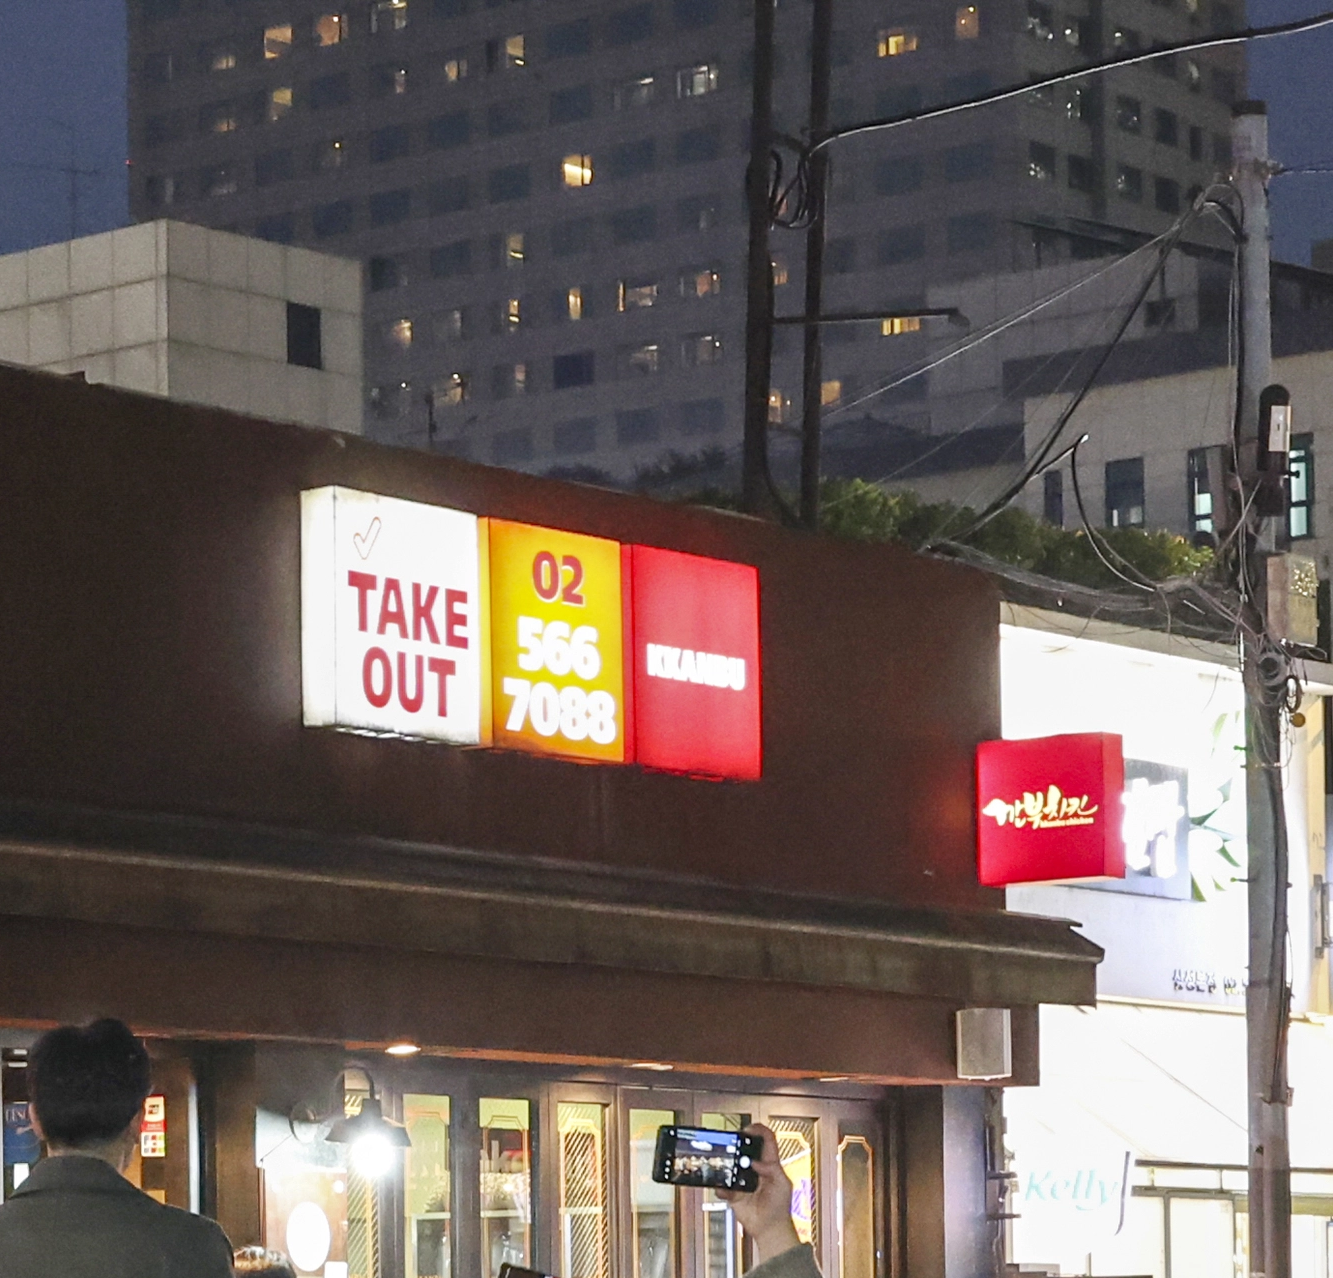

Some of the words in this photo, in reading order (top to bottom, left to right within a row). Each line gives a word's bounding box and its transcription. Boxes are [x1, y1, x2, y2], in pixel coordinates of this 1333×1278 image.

[532, 550, 584, 607] 02
[347, 570, 469, 650] TAKE
[517, 616, 600, 681] 566
[646, 643, 746, 691] KKANBU
[362, 646, 456, 718] OUT
[502, 677, 617, 745] 7088
[982, 785, 1099, 830] 깐부치킨
[1025, 1169, 1118, 1211] Kelly
